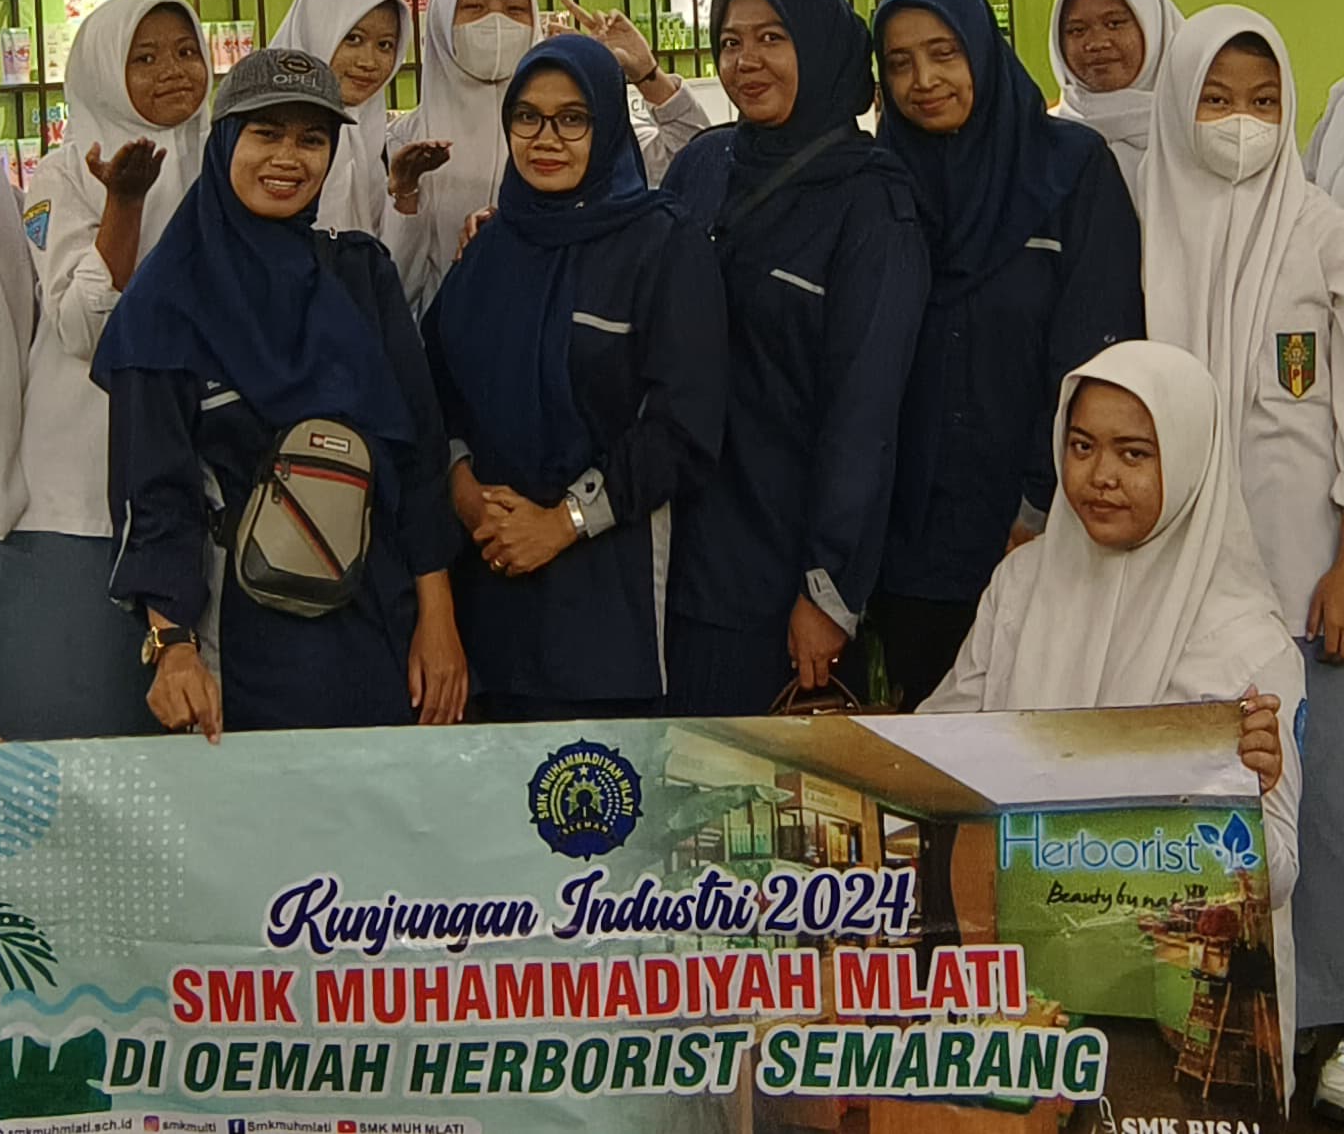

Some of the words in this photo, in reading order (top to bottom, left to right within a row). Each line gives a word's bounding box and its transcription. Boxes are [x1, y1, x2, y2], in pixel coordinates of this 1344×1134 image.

[539, 751, 625, 792] MUHAMMADIYAH
[536, 793, 550, 820] SMK
[618, 778, 635, 817] MLATI
[1000, 812, 1201, 872] Herborist
[267, 876, 539, 957] Kunjungan
[552, 869, 757, 940] Industri
[764, 872, 912, 932] 2024
[1046, 879, 1113, 915] Beauty
[1115, 881, 1139, 914] by
[172, 968, 298, 1024] SMK
[316, 953, 816, 1025] MUHAMMADIYAH
[839, 949, 1022, 1010] MLATI
[110, 1037, 167, 1089] DI
[183, 1040, 391, 1093] OEMAH
[409, 1030, 749, 1095] HERBORIST
[762, 1029, 1102, 1094] SEMARANG
[359, 1122, 387, 1134] SMK
[391, 1123, 422, 1134] MUH
[424, 1124, 465, 1134] MLATI
[1121, 1118, 1179, 1134] SMK
